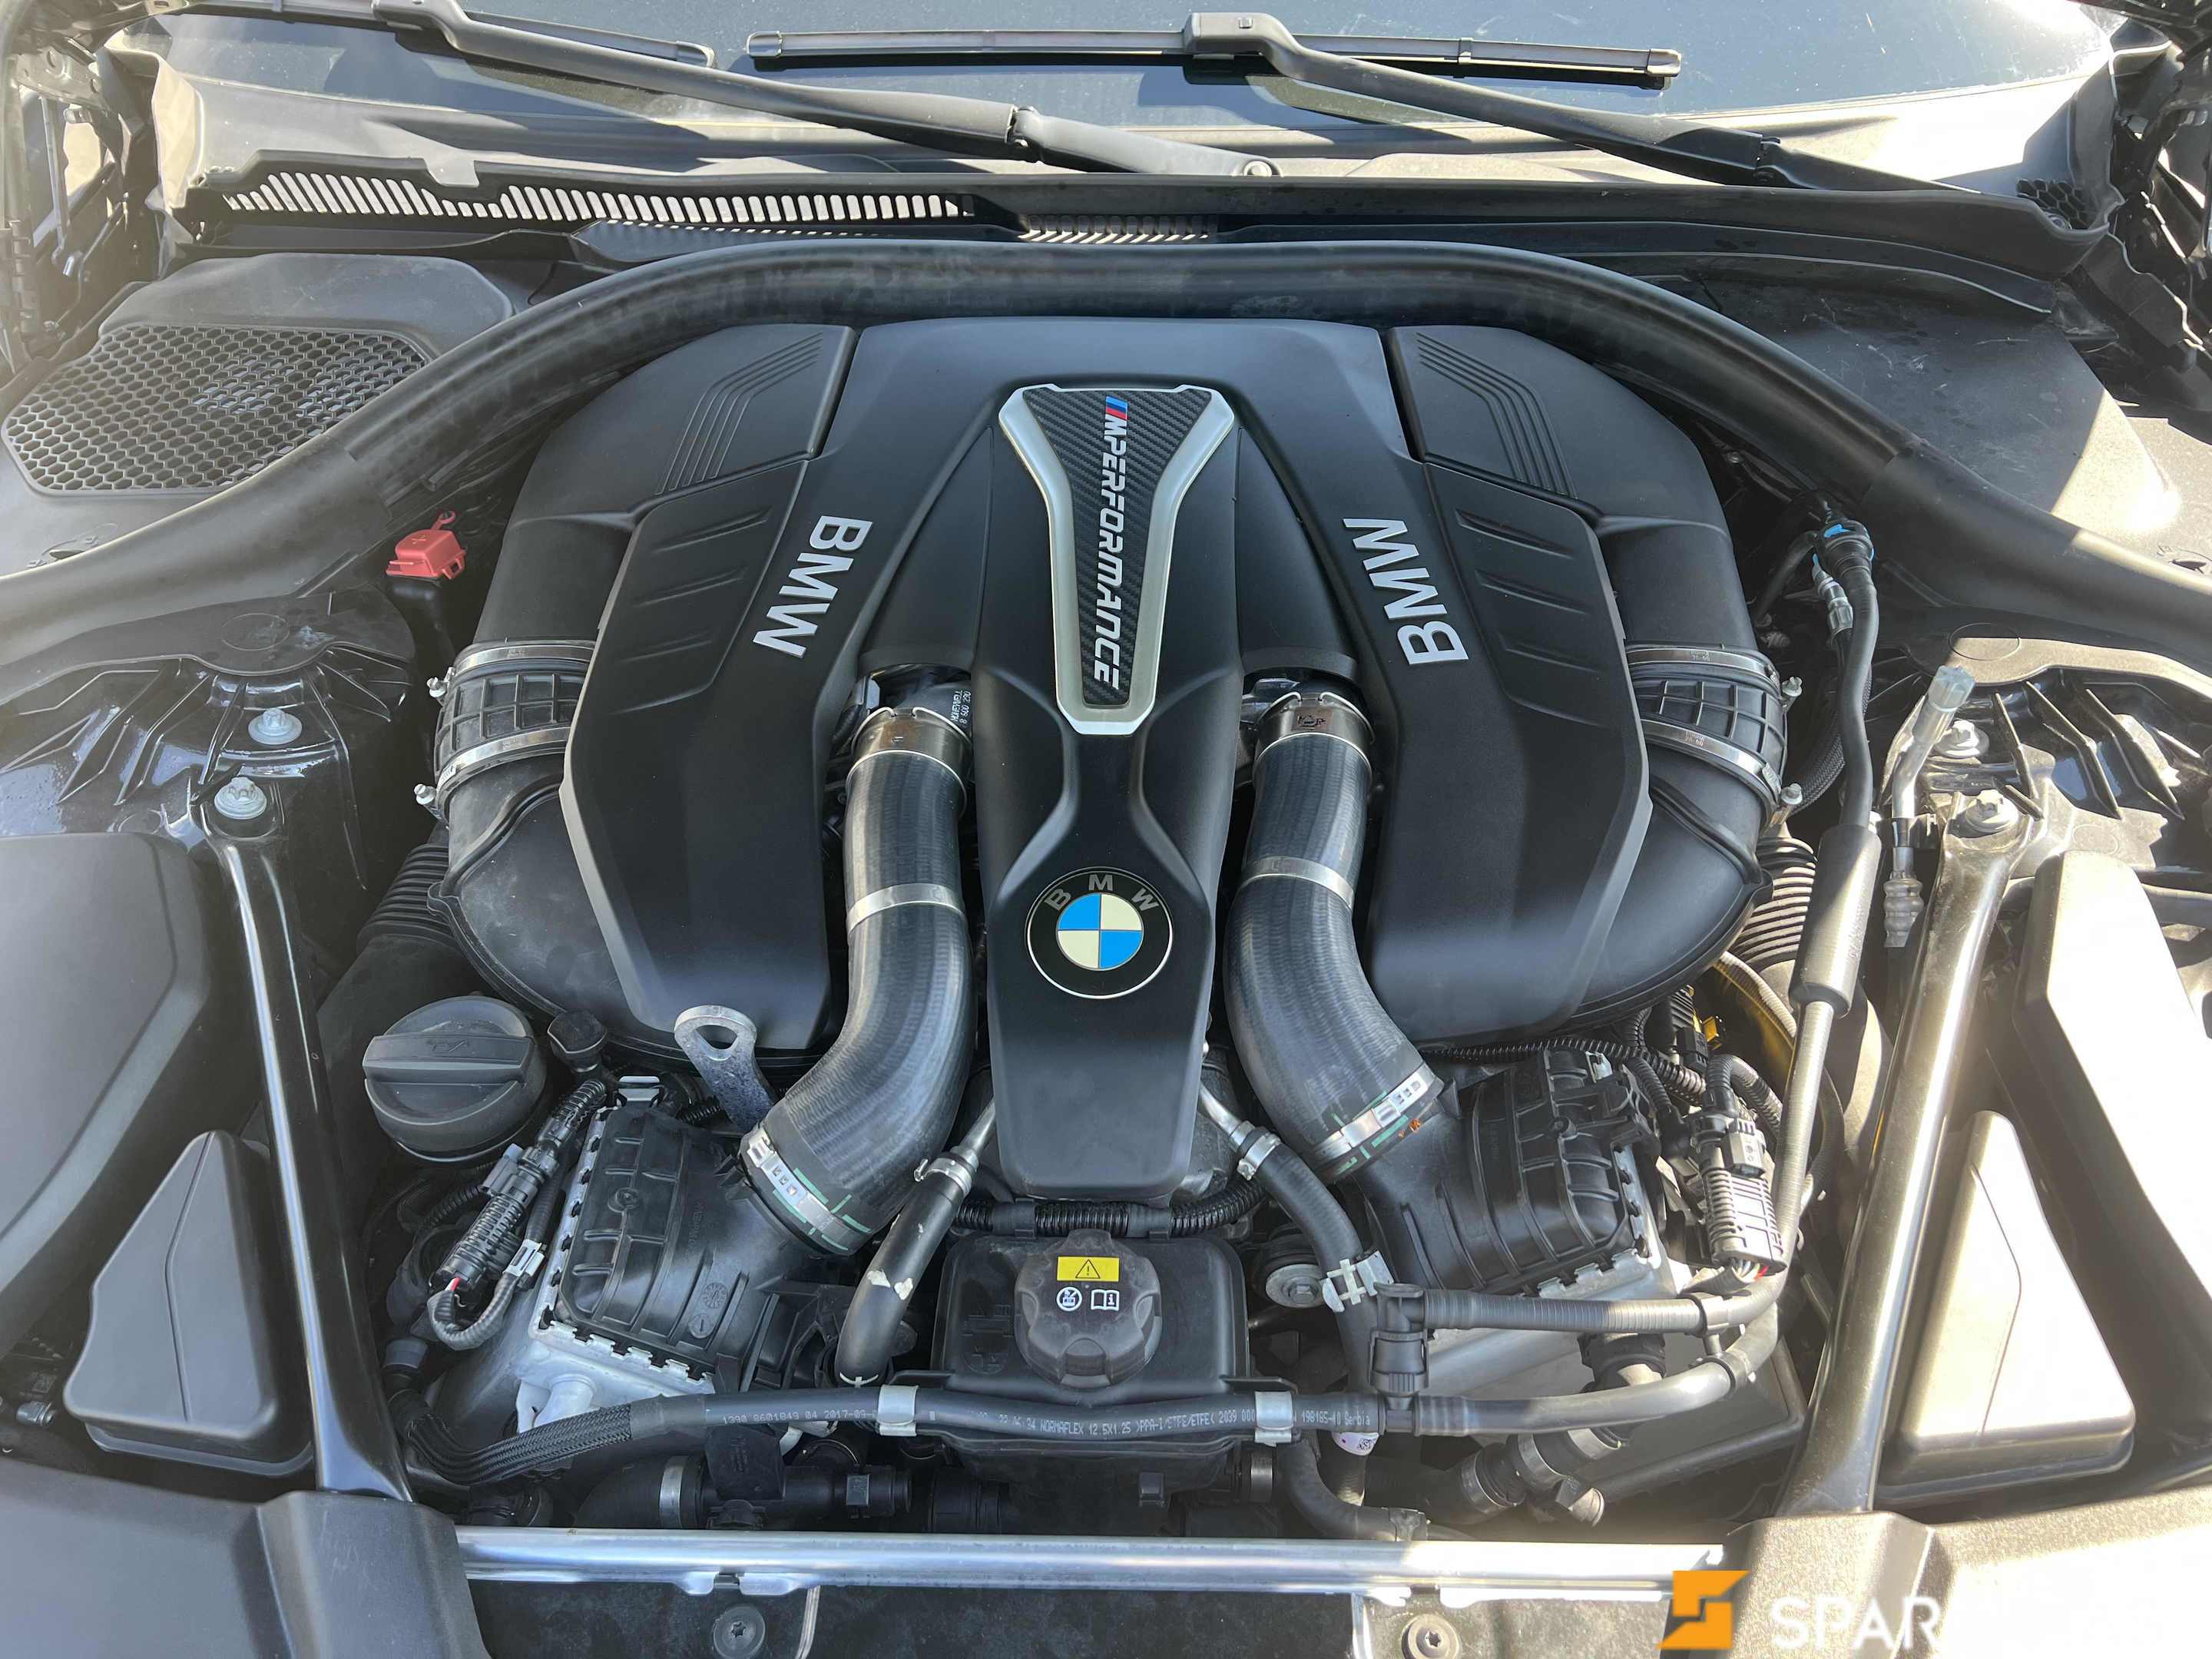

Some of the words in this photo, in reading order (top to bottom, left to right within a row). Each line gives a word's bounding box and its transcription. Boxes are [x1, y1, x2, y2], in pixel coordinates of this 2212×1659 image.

[752, 515, 873, 659] BMW
[1094, 435, 1127, 690] PERFORMANCE
[1343, 518, 1469, 665] BMW
[1044, 873, 1160, 912] BMW
[1040, 1418, 1084, 1435] NORMAFLEX
[1344, 1410, 1371, 1426] Serbia
